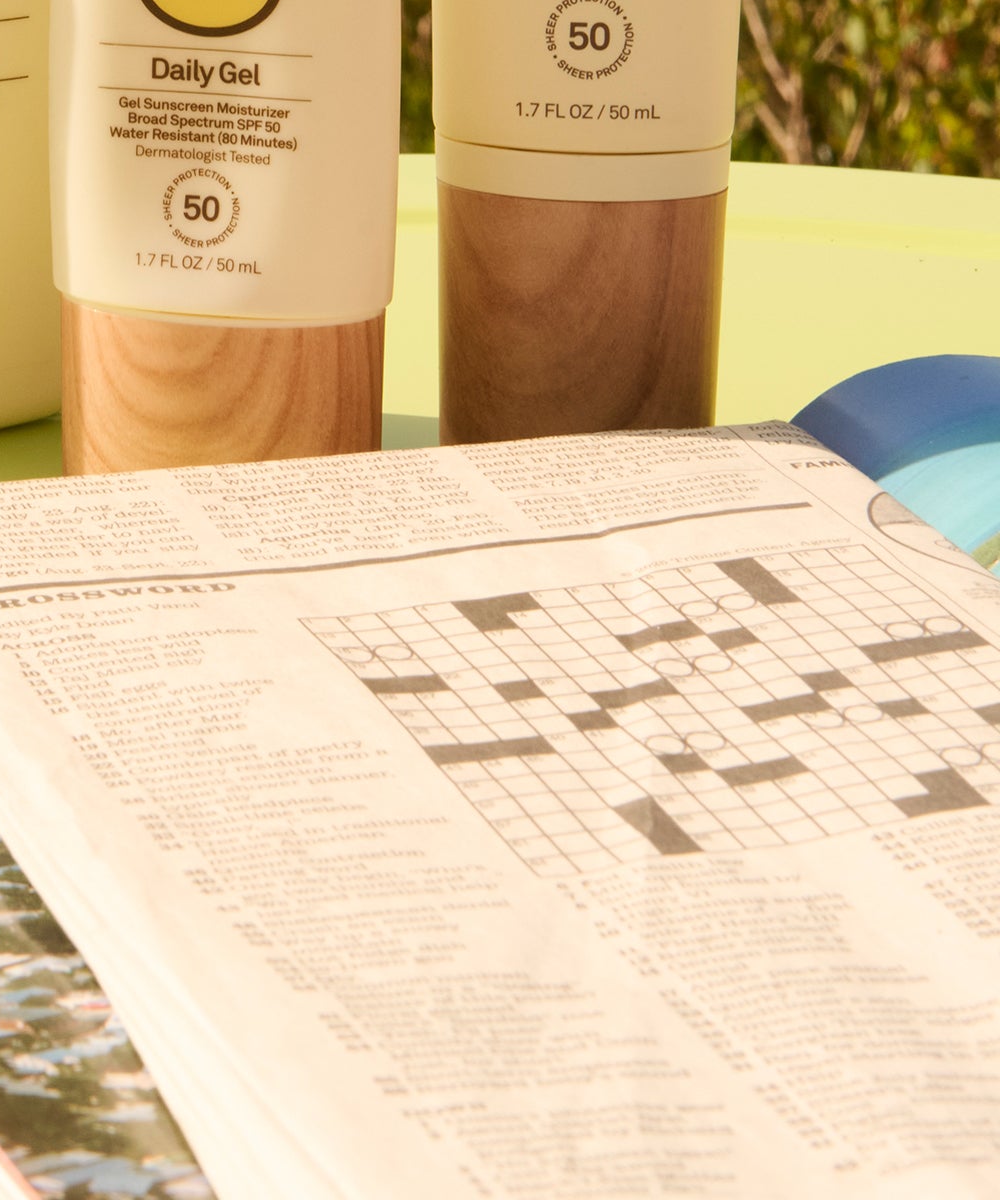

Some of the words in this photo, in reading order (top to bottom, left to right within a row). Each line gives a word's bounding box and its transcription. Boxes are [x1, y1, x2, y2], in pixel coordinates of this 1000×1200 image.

[545, 12, 560, 52] SHEER
[569, 22, 610, 51] 50
[557, 59, 594, 80] SHEER
[596, 22, 635, 79] PROTECTION
[152, 58, 214, 88] Daily
[219, 61, 260, 86] Gel
[119, 96, 140, 108] Gel
[144, 98, 213, 112] Sunscreen
[217, 102, 290, 118] Moisturizer
[516, 102, 539, 117] 1.7
[545, 103, 565, 118] FL
[570, 104, 593, 119] OZ
[597, 105, 605, 119] /
[610, 105, 629, 120] 50
[635, 105, 660, 119] mL
[128, 112, 167, 125] Broad
[170, 114, 234, 130] Spectrum
[237, 119, 262, 131] SPF
[265, 121, 280, 133] 50
[110, 127, 149, 139] Water
[153, 128, 215, 143] Resistant
[218, 131, 237, 145] (80
[241, 134, 297, 151] Minutes)
[136, 145, 226, 164] Dermatologist
[230, 151, 270, 165] Tested
[162, 185, 176, 221] SHEER
[172, 168, 232, 191] PROTECTION
[184, 195, 219, 222] 50
[172, 228, 204, 248] SHEER
[206, 197, 241, 248] PROTECTION
[136, 253, 156, 266] 1.7
[161, 254, 178, 268] FL
[182, 256, 203, 270] OZ
[206, 257, 213, 270] /
[217, 258, 234, 272] 50
[239, 261, 261, 274] mL
[221, 487, 323, 503] Capricorn
[260, 528, 351, 544] Aquarius
[1, 632, 97, 651] ACROSS
